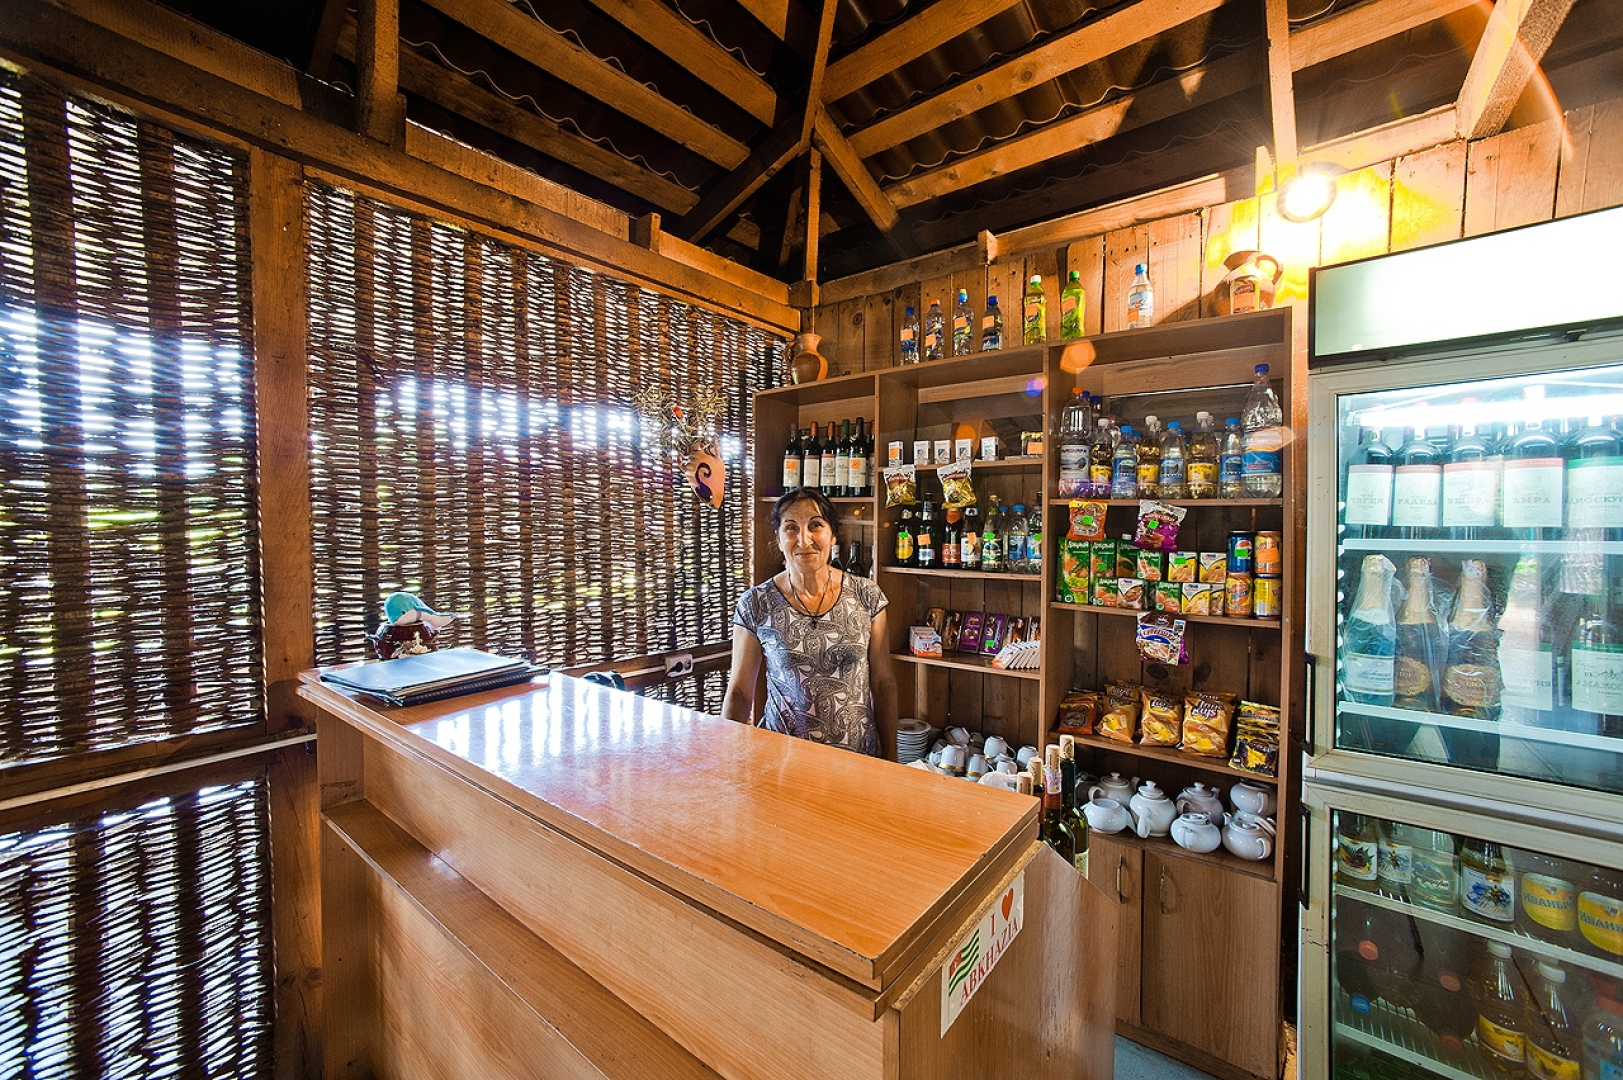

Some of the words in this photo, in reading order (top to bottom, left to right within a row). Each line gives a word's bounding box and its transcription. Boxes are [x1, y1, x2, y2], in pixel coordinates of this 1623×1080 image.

[1513, 496, 1552, 504] АМРА
[989, 912, 996, 939] I
[959, 915, 1019, 1007] ABKHAZIA
